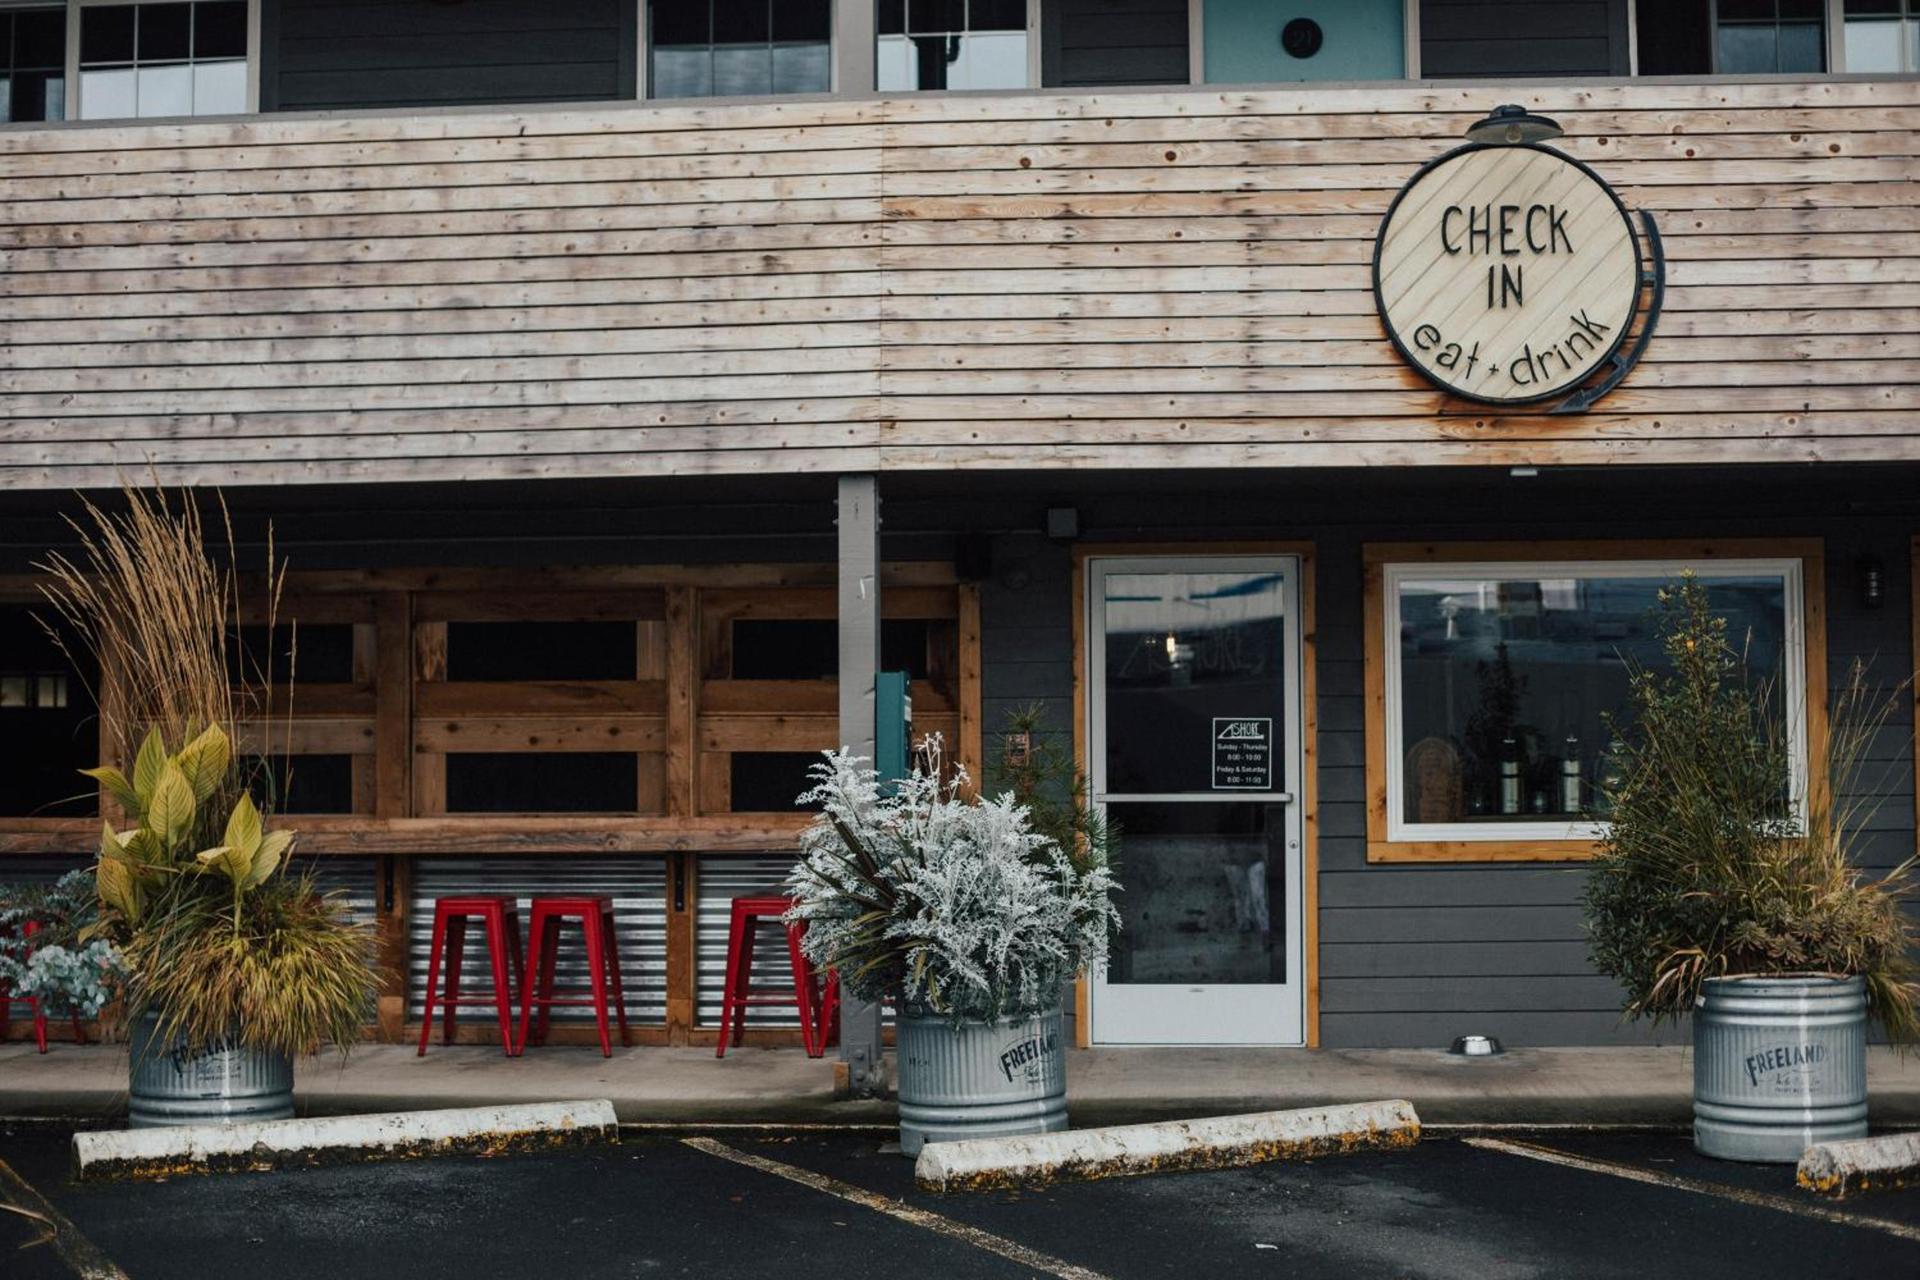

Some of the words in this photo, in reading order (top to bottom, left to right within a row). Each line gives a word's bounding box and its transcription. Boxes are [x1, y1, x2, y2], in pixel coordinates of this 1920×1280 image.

[1442, 203, 1574, 256] CHECK
[1487, 264, 1523, 309] IN
[1413, 323, 1480, 380] eat
[1510, 308, 1610, 386] drink
[1216, 743, 1238, 752] Sunday
[1243, 743, 1268, 752] Thursday
[1217, 722, 1264, 739] ASHORE
[1216, 766, 1235, 774] Friday
[1241, 766, 1267, 774] Saturday
[1746, 1044, 1825, 1087] FREELAND
